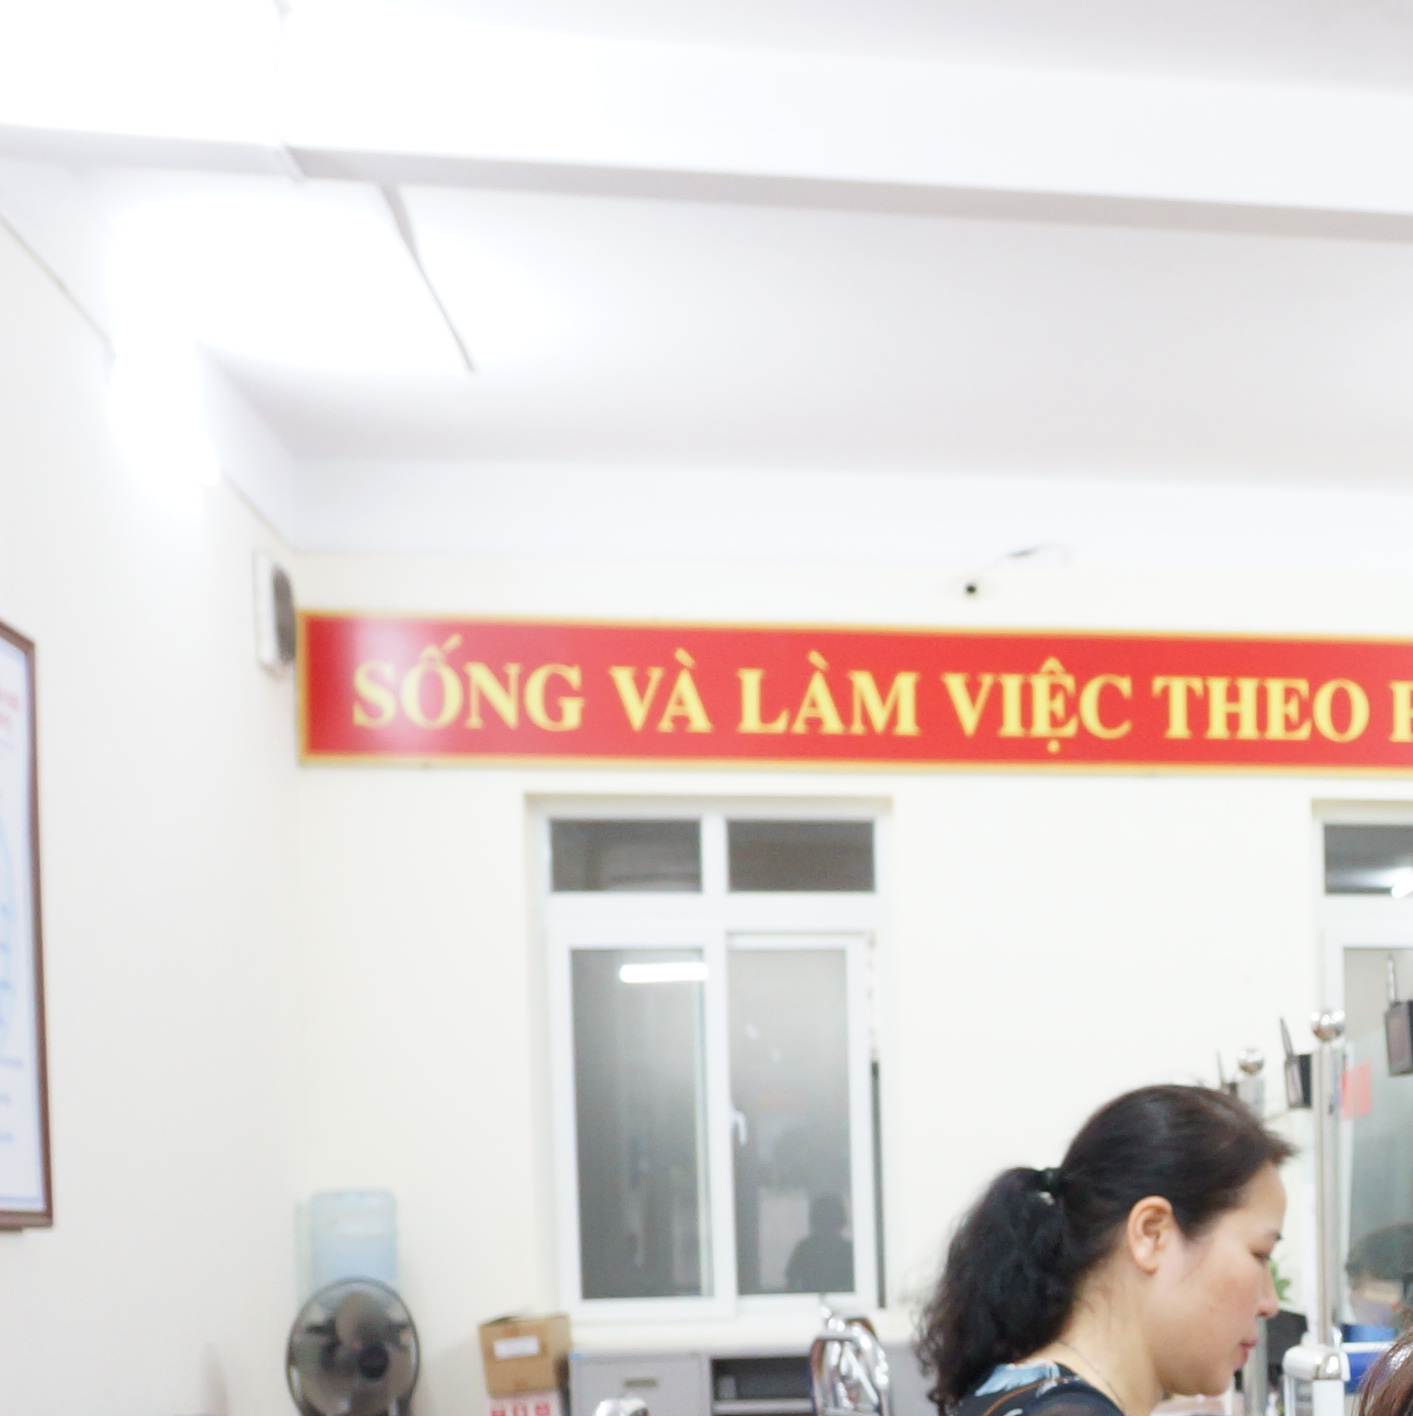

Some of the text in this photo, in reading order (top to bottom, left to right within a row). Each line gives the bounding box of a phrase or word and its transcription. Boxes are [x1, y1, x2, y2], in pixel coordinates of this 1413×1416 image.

[351, 633, 585, 732] SỐNG
[609, 647, 711, 734] VÀ
[738, 651, 921, 737] LÀM
[944, 656, 1132, 753] VIỆC
[1153, 675, 1370, 742] THEO
